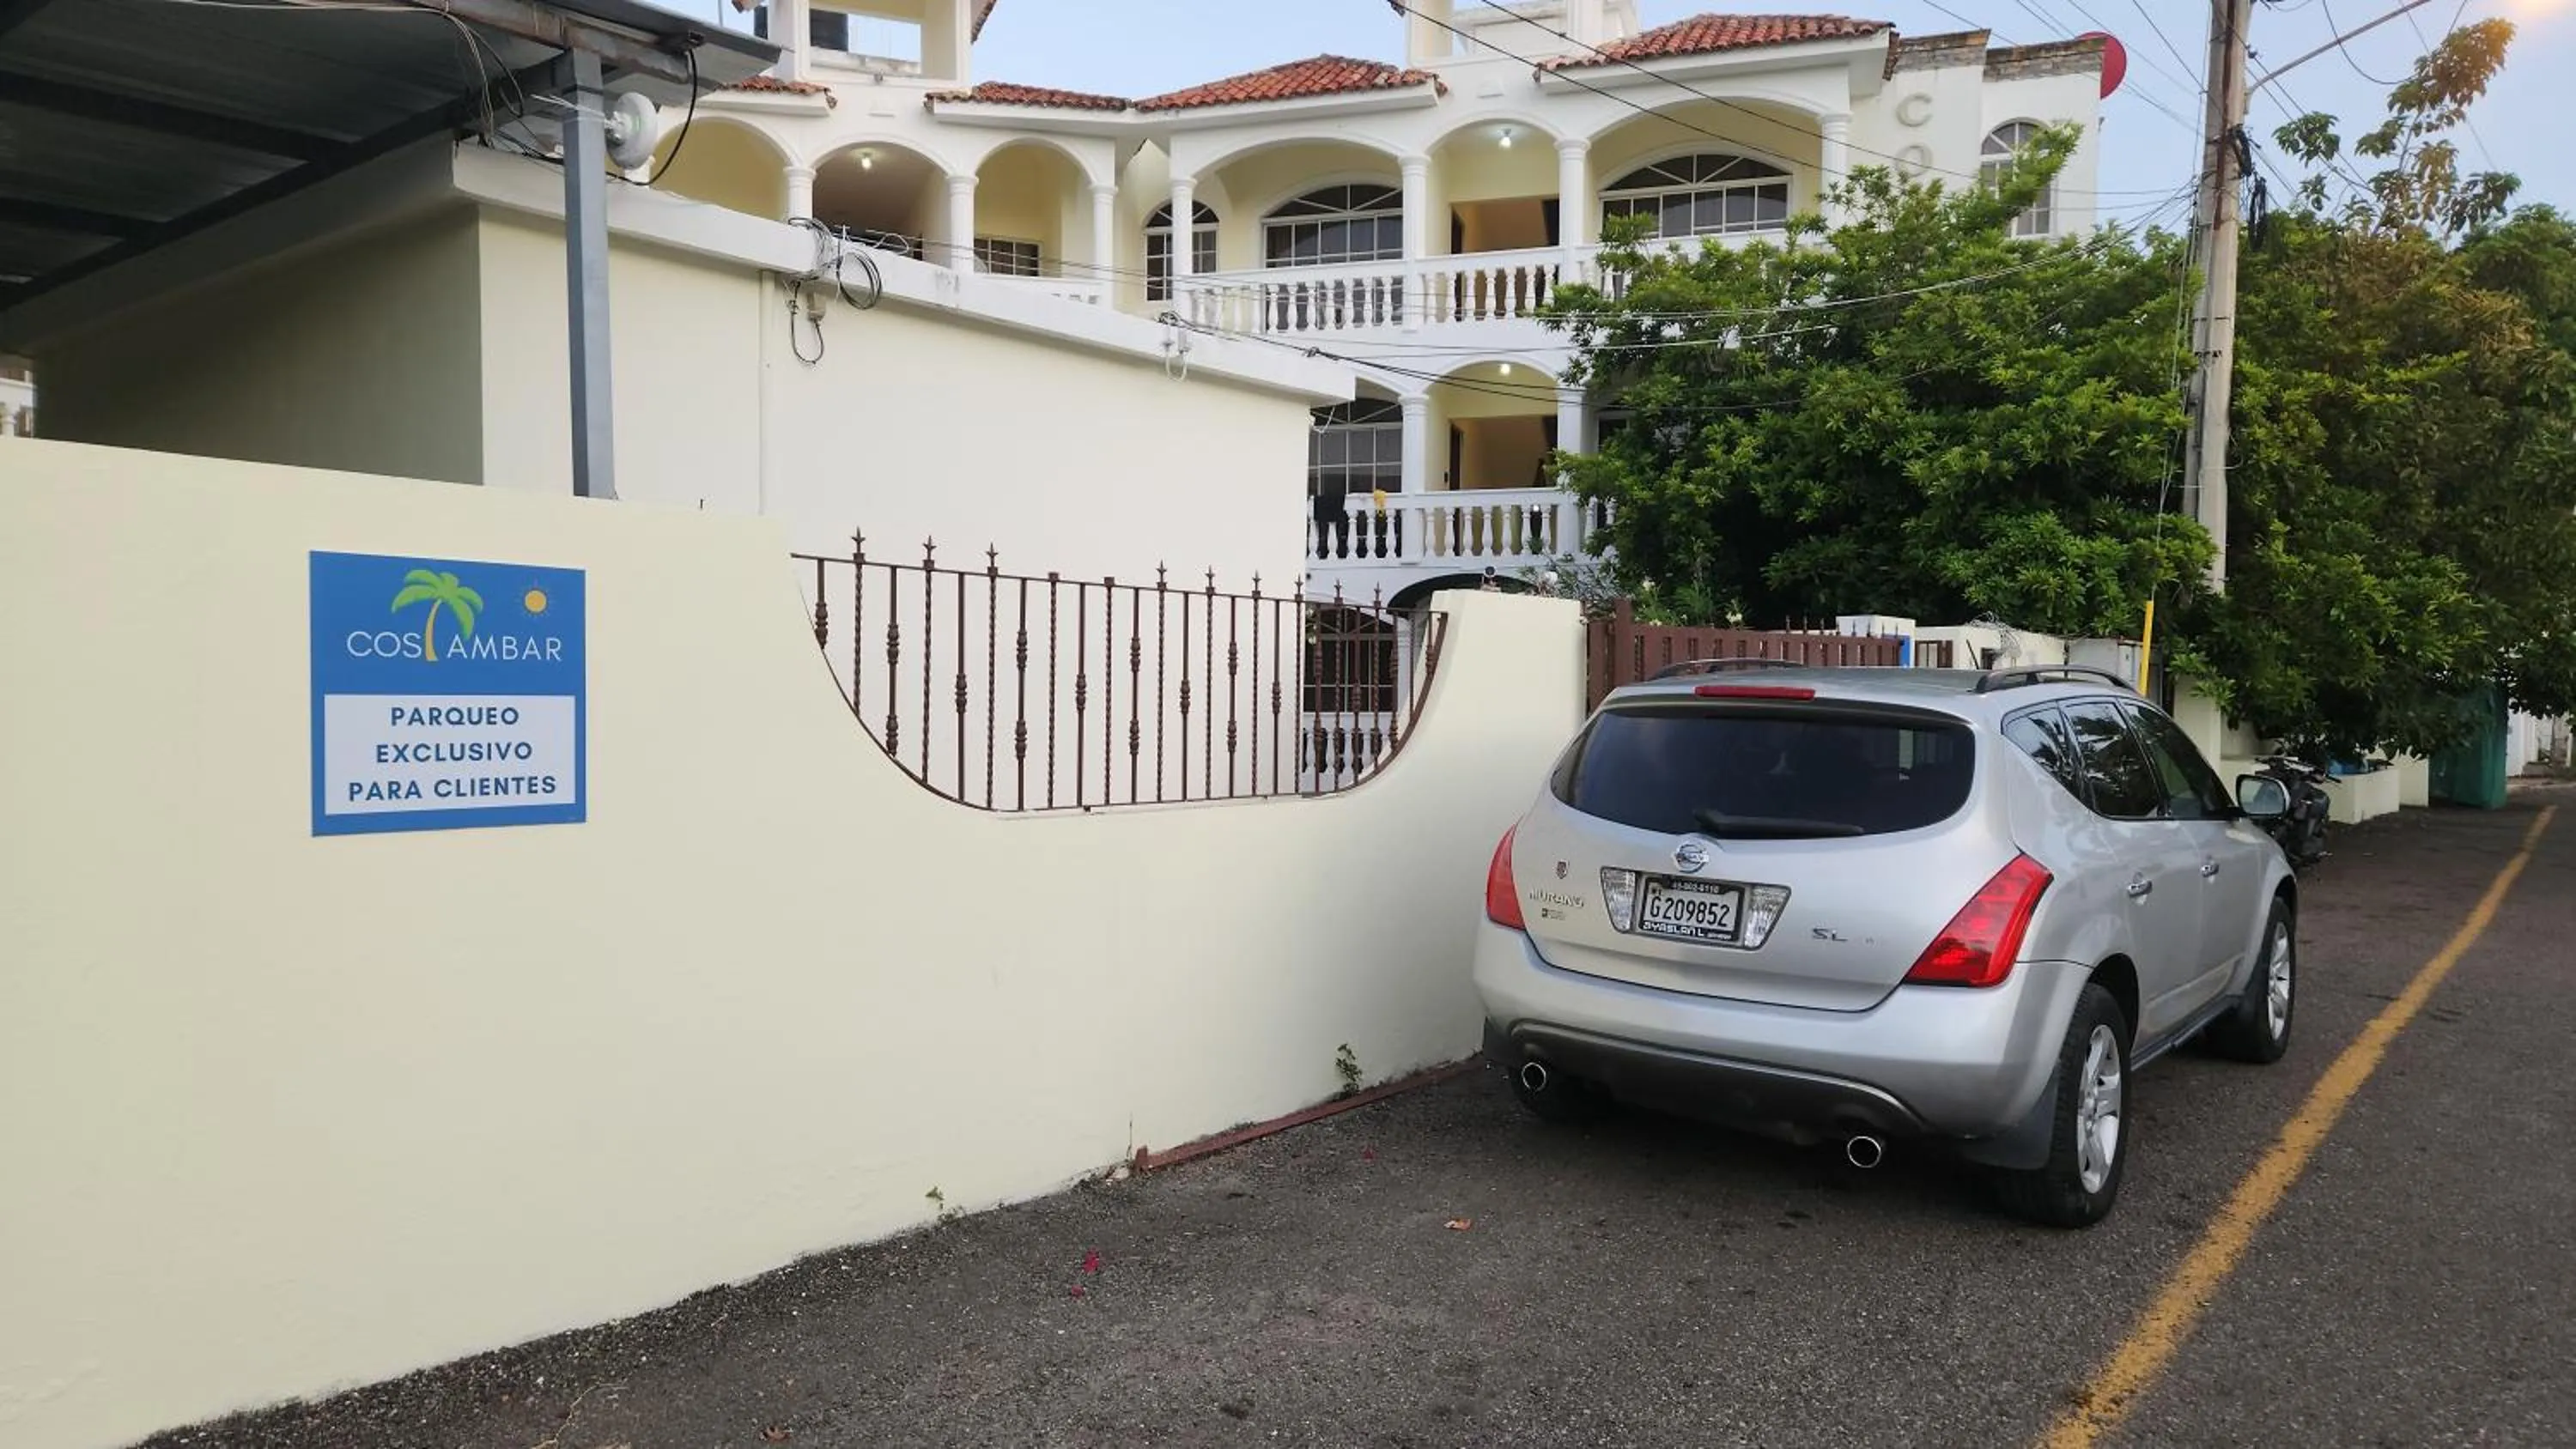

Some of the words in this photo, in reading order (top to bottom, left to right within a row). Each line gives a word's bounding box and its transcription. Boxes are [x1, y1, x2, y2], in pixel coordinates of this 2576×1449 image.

[391, 706, 519, 726] PARQUEO
[376, 742, 533, 763] EXCLUSIVO
[349, 781, 422, 802] PARA
[434, 775, 556, 798] CLIENTES
[1649, 896, 1730, 927] G209852
[1813, 928, 1848, 942] SL
